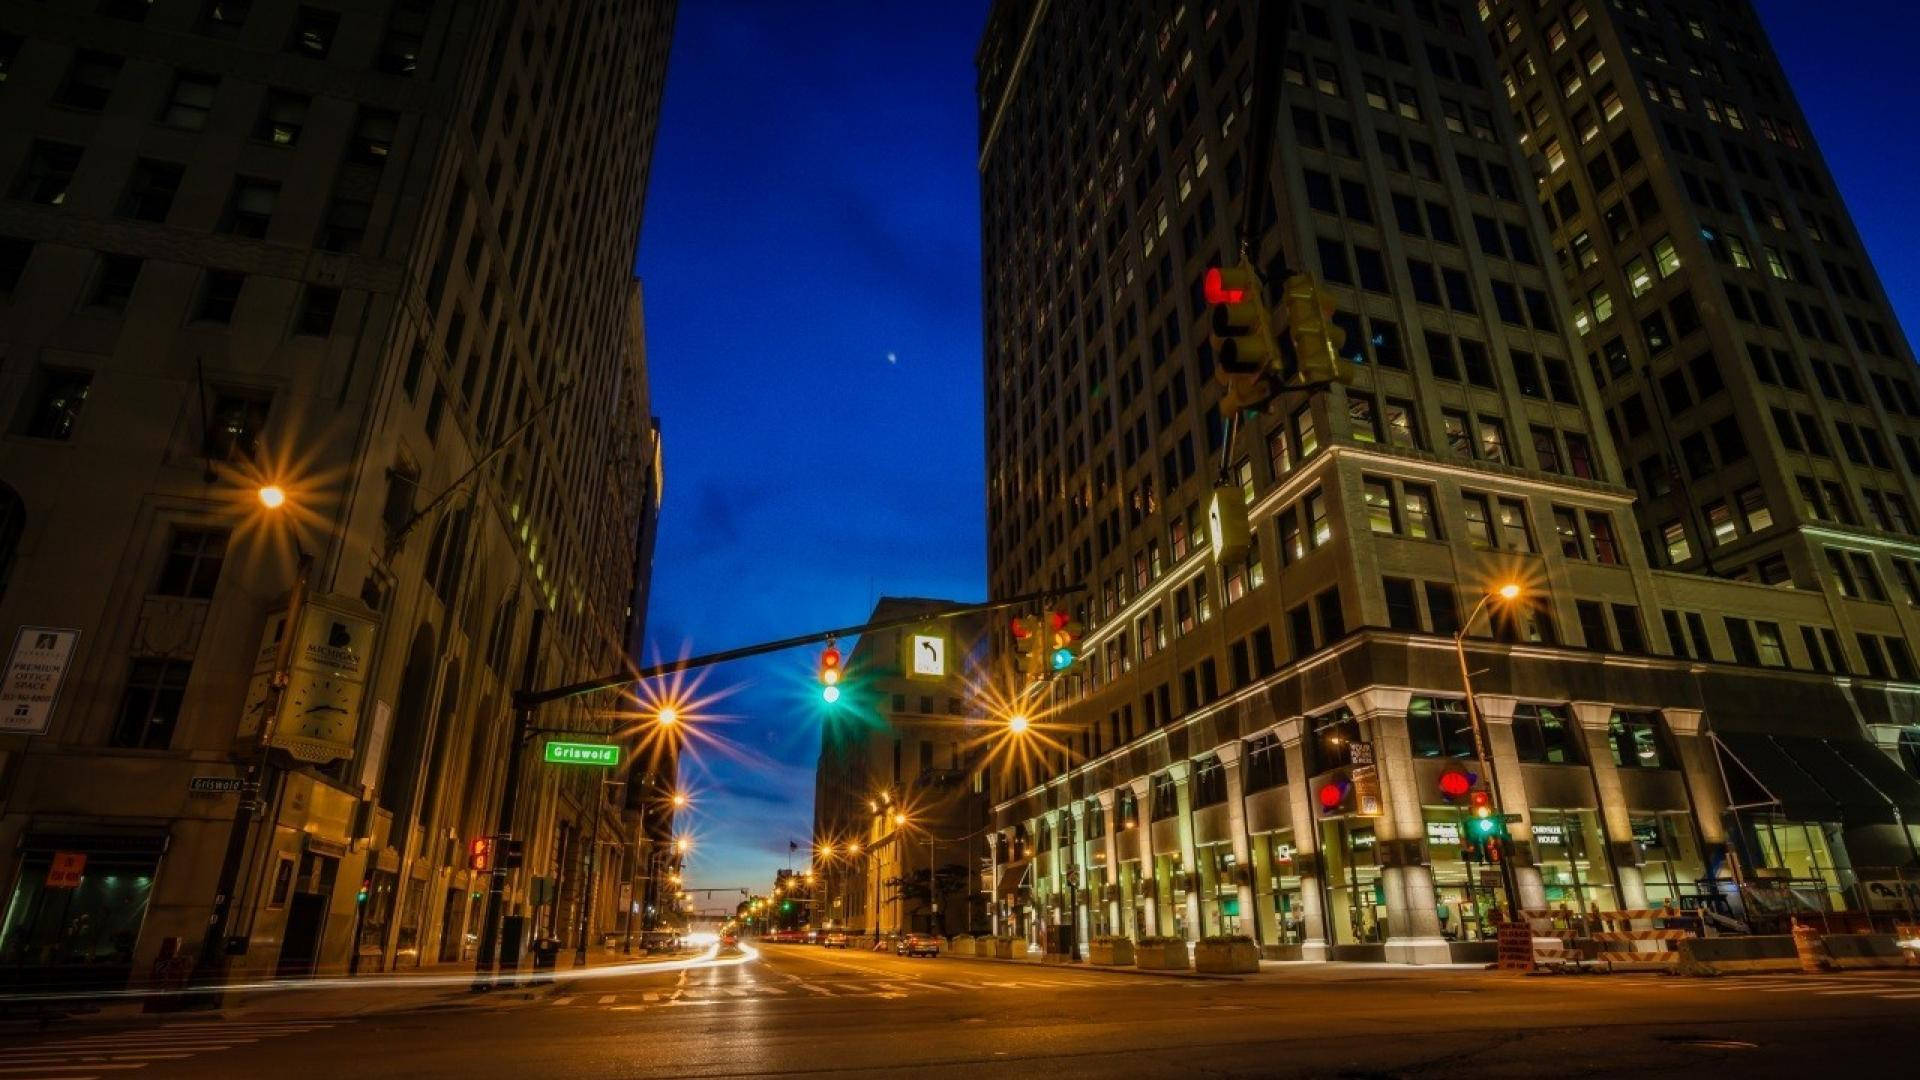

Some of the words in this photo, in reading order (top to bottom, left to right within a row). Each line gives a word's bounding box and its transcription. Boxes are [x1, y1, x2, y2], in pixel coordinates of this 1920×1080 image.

[307, 644, 361, 662] MICHIGAN
[14, 662, 61, 672] PREMIUM
[15, 672, 50, 681] OFFICE
[15, 681, 46, 690] SPACE
[554, 746, 611, 760] Griswold
[193, 779, 241, 791] Griswold
[1538, 835, 1561, 844] HOUSE
